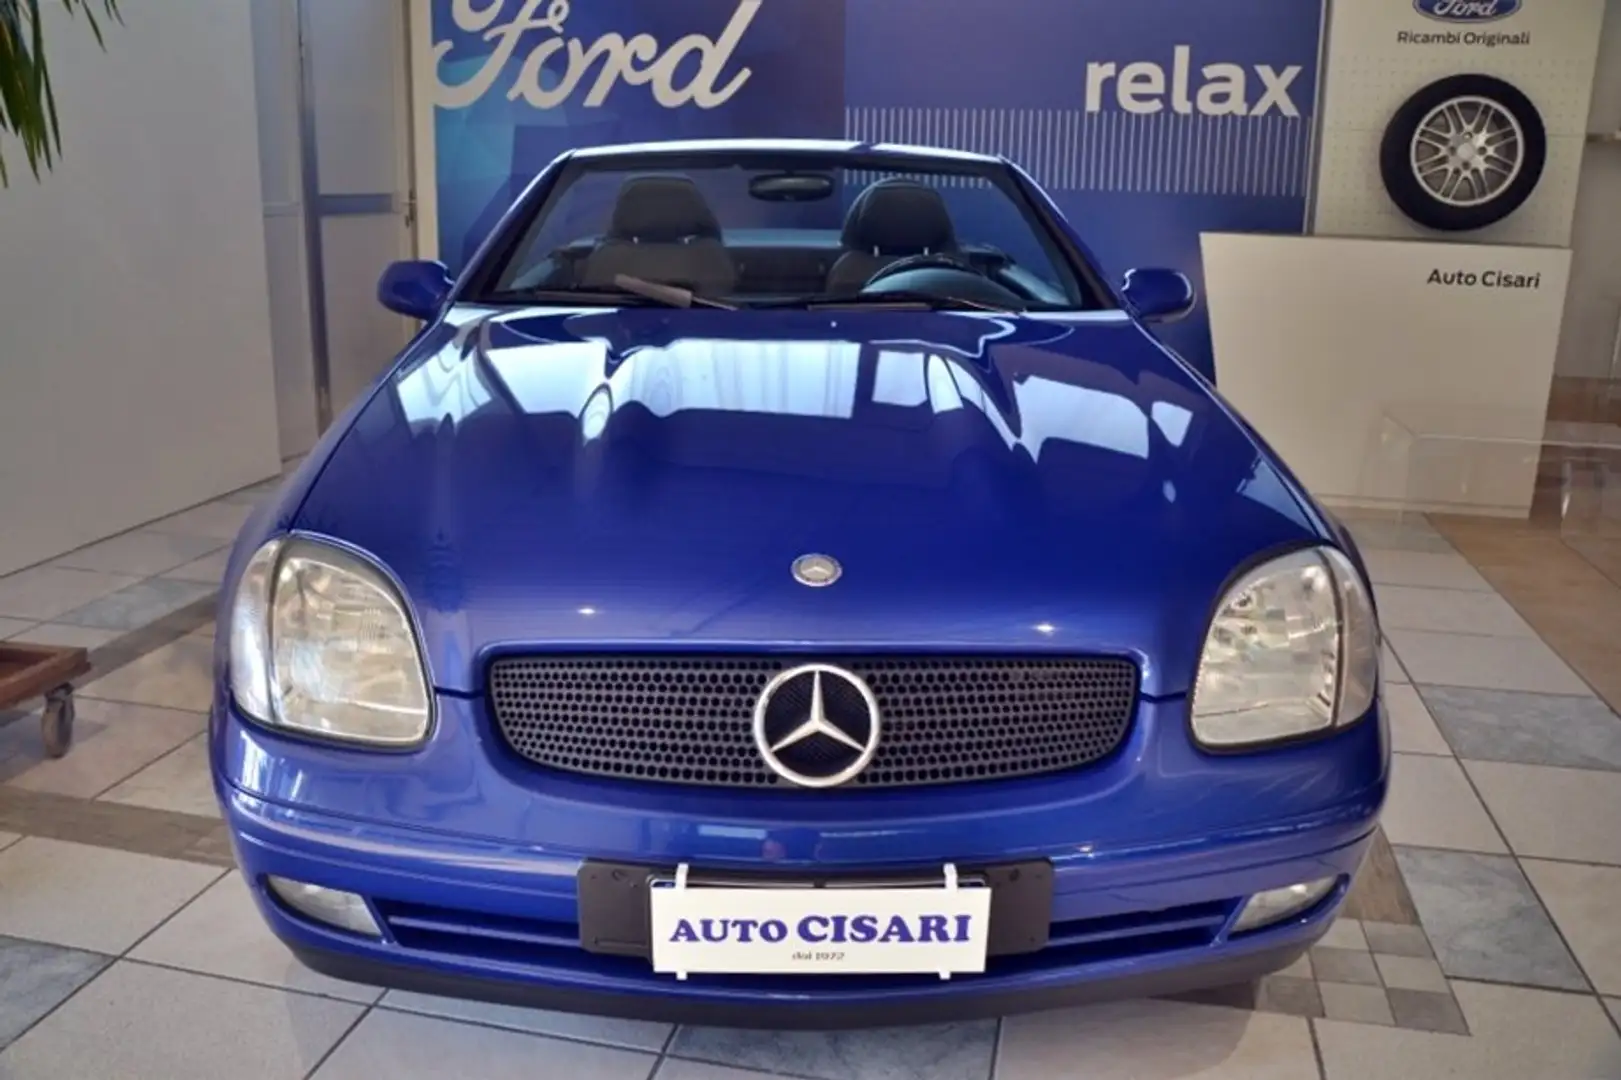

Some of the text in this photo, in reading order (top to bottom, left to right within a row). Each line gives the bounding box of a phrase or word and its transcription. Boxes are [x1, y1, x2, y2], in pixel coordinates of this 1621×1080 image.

[1396, 30, 1530, 48] Ricambi Originali
[1086, 45, 1302, 118] relax
[1427, 267, 1541, 289] Auto Cisari
[669, 915, 972, 942] AUTO CISARI
